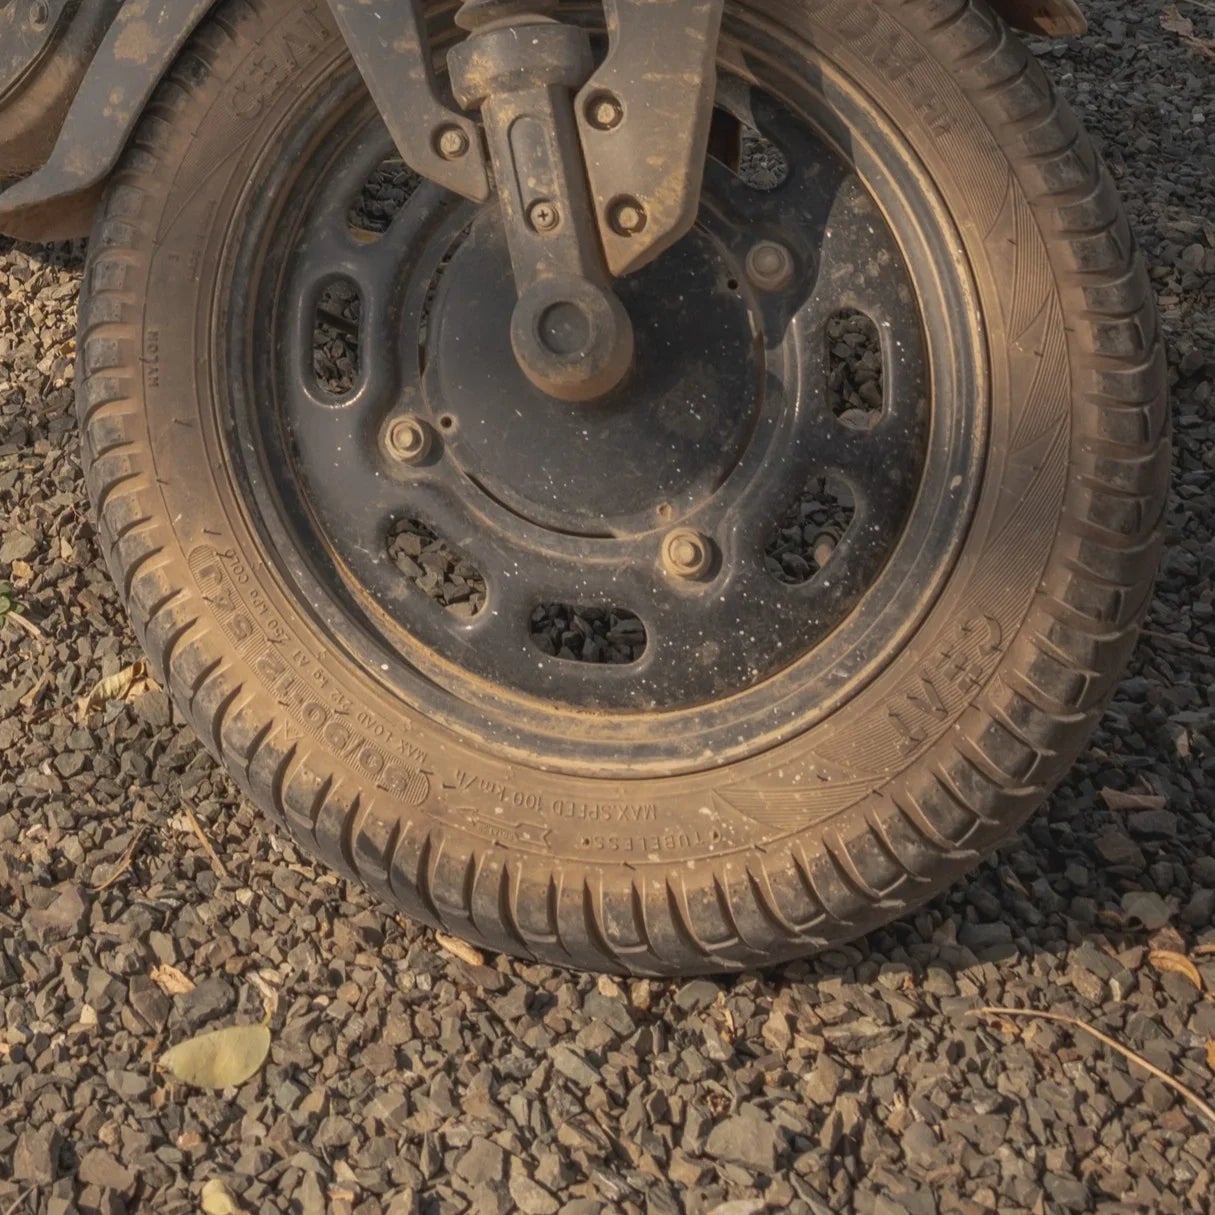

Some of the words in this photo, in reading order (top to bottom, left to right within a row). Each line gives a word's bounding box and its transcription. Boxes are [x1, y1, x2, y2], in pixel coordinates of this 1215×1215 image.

[228, 3, 333, 121] CEAT
[886, 614, 1004, 747] CEAT
[354, 709, 395, 743] LOAD
[392, 735, 429, 763] MAX
[512, 791, 543, 812] 100
[590, 830, 704, 852] TUBELESS
